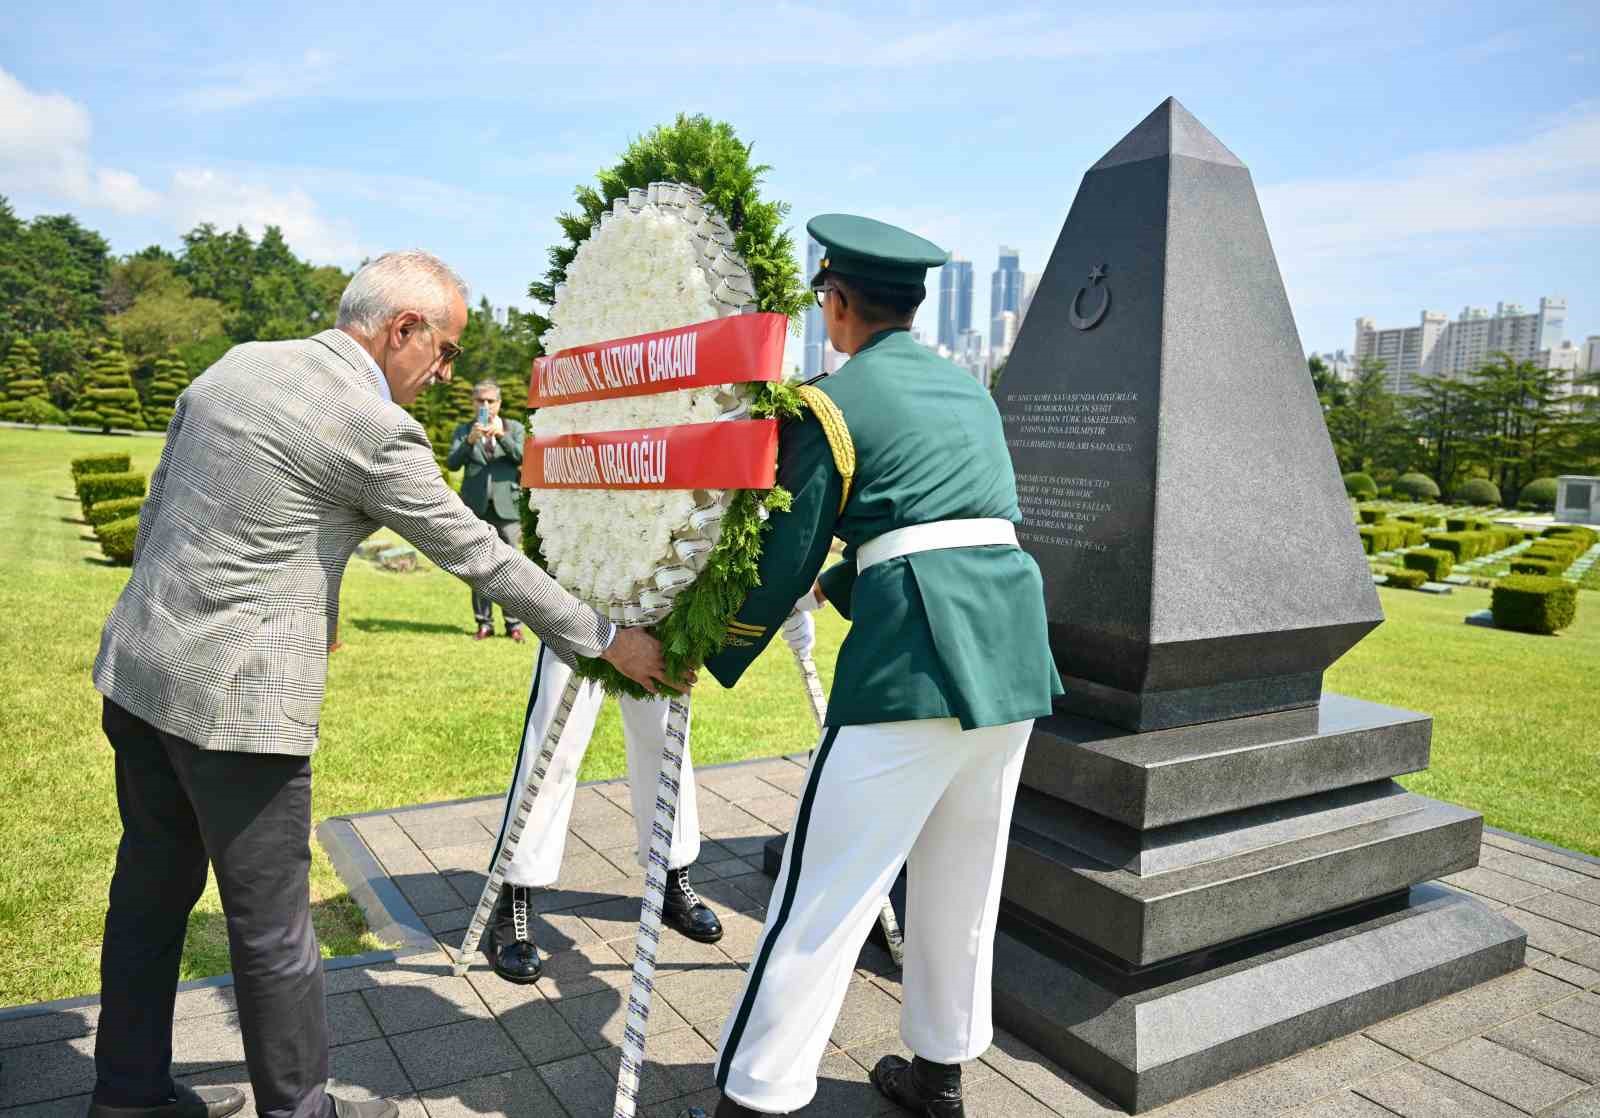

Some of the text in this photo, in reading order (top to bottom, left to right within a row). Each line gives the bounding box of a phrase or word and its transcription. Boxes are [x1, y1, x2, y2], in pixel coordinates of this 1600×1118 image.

[584, 351, 604, 390] VE
[600, 341, 645, 390] ALTYAPI
[648, 331, 697, 382] BAKANI
[544, 433, 667, 484] ABDULKADİR URALOĞLU
